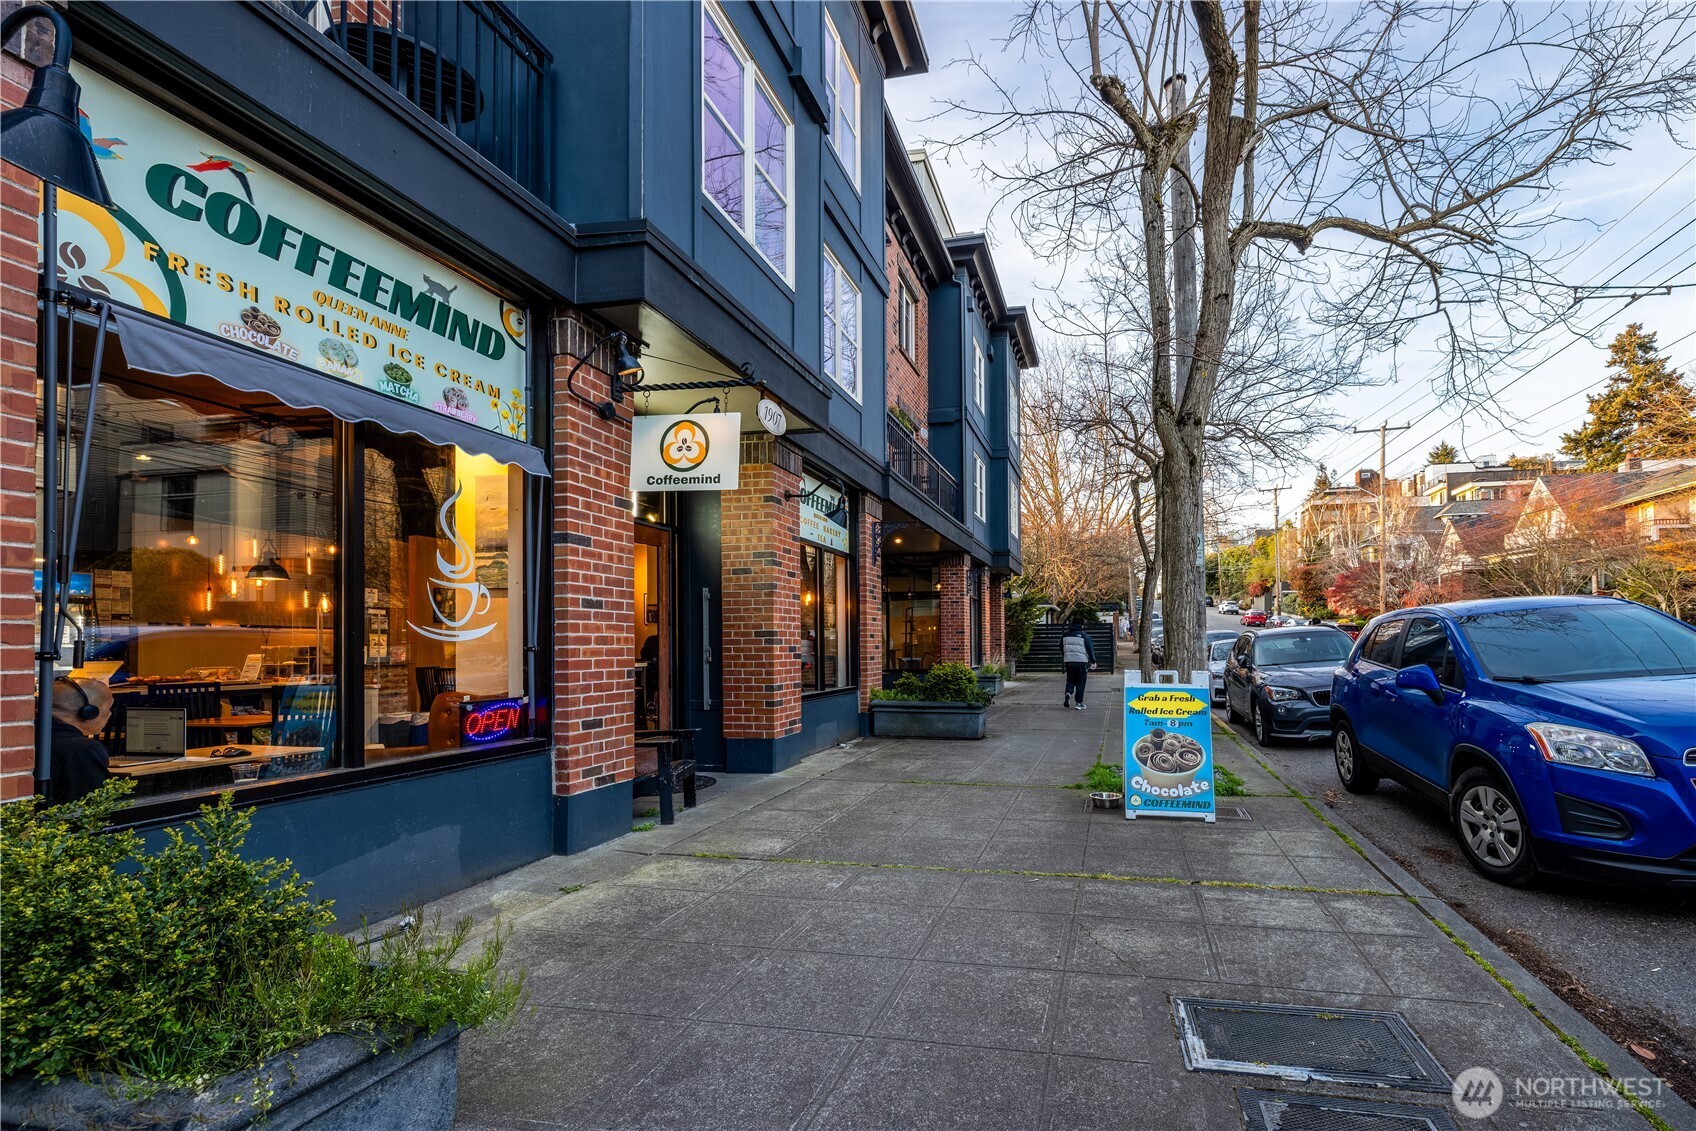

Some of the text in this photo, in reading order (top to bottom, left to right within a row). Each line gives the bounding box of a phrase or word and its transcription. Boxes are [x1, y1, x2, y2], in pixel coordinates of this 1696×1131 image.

[145, 163, 506, 361] COFFEEMIND
[143, 240, 501, 400] FRESH ROLLED ICE CREAM
[312, 290, 410, 341] QUEEN ANNE
[220, 324, 299, 361] CHOCOLATE
[379, 380, 419, 402] MATCHA
[764, 405, 783, 429] 1907
[646, 473, 721, 486] Coffeemind
[817, 534, 826, 543] TEA
[823, 525, 840, 538] BAKERY
[1137, 694, 1160, 703] Grab
[1169, 694, 1196, 703] Fresh
[466, 708, 521, 735] OPEN
[1128, 707, 1207, 716] Rolled Ice Cream
[1130, 776, 1210, 797] Chocolate
[1143, 798, 1211, 809] COFFEEMIND
